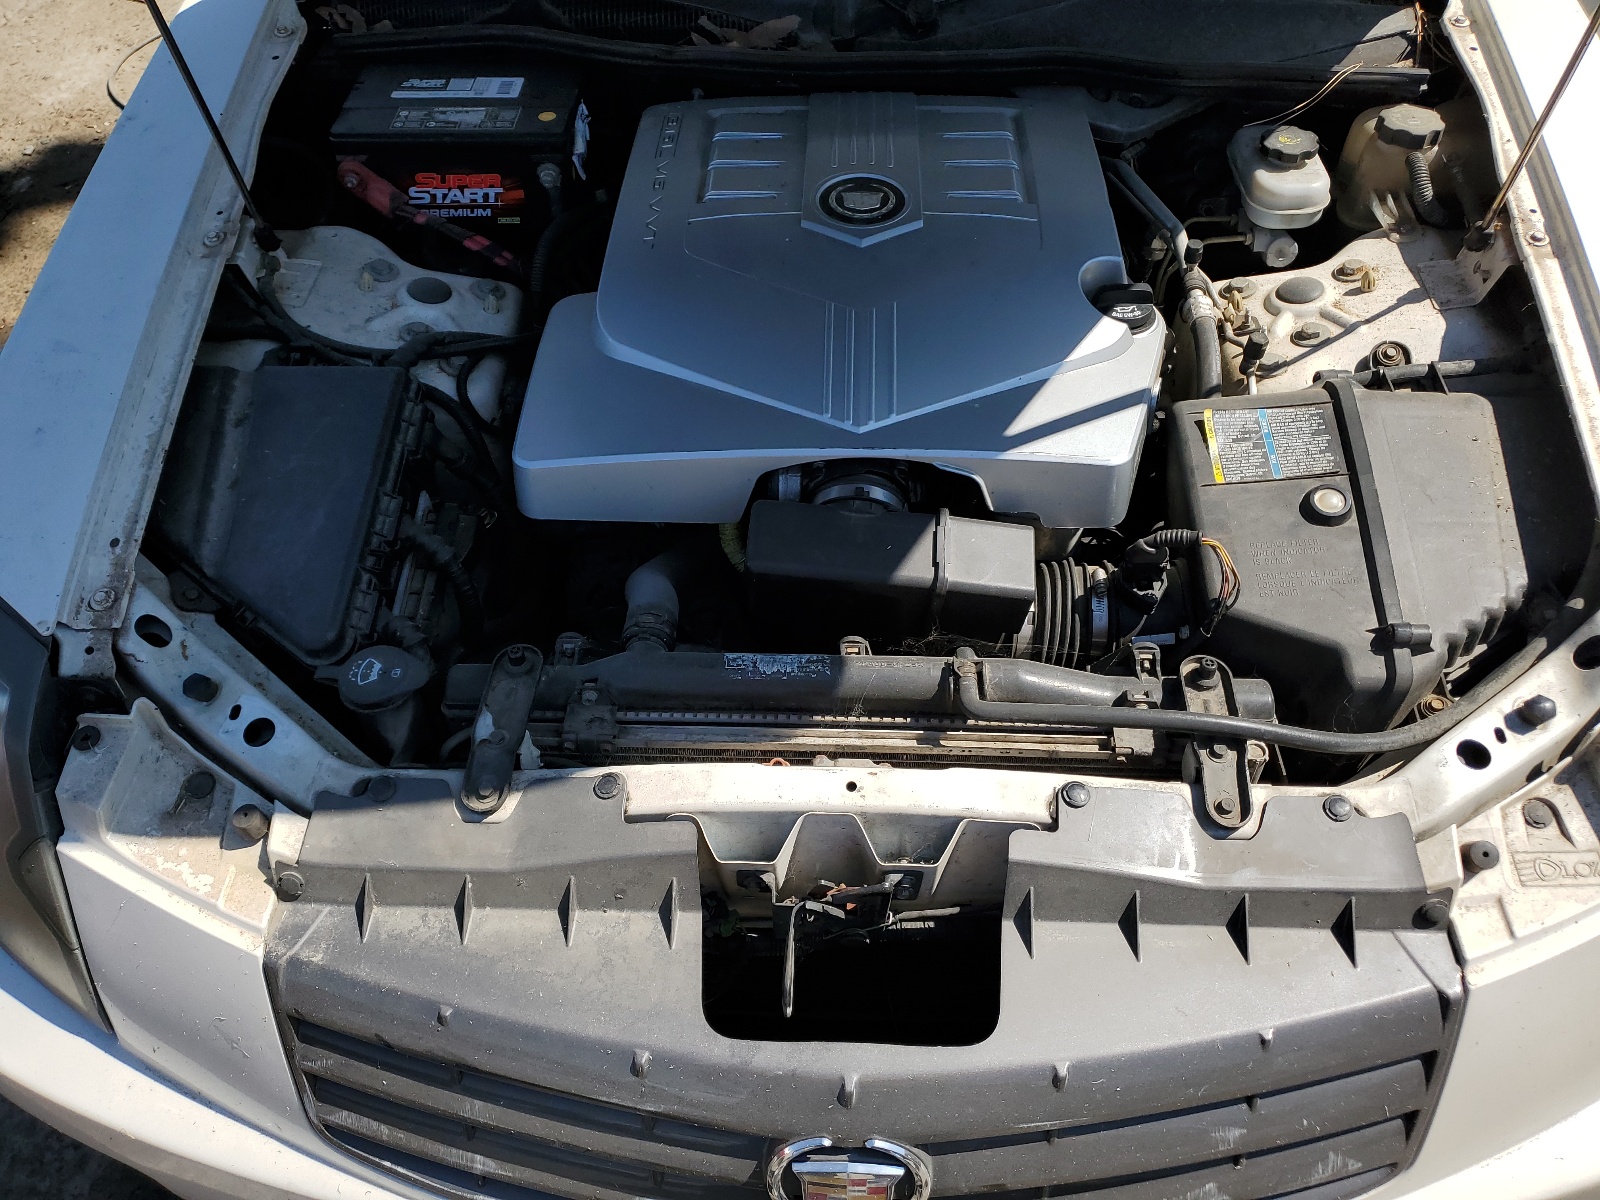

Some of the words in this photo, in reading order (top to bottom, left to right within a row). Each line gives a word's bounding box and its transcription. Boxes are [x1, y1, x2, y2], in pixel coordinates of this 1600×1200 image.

[415, 172, 501, 188] SUPER
[653, 160, 669, 190] V6
[408, 187, 503, 204] START
[1249, 541, 1286, 549] REPLACE
[1290, 539, 1320, 547] FILTER
[1280, 547, 1326, 556] INDICATOR
